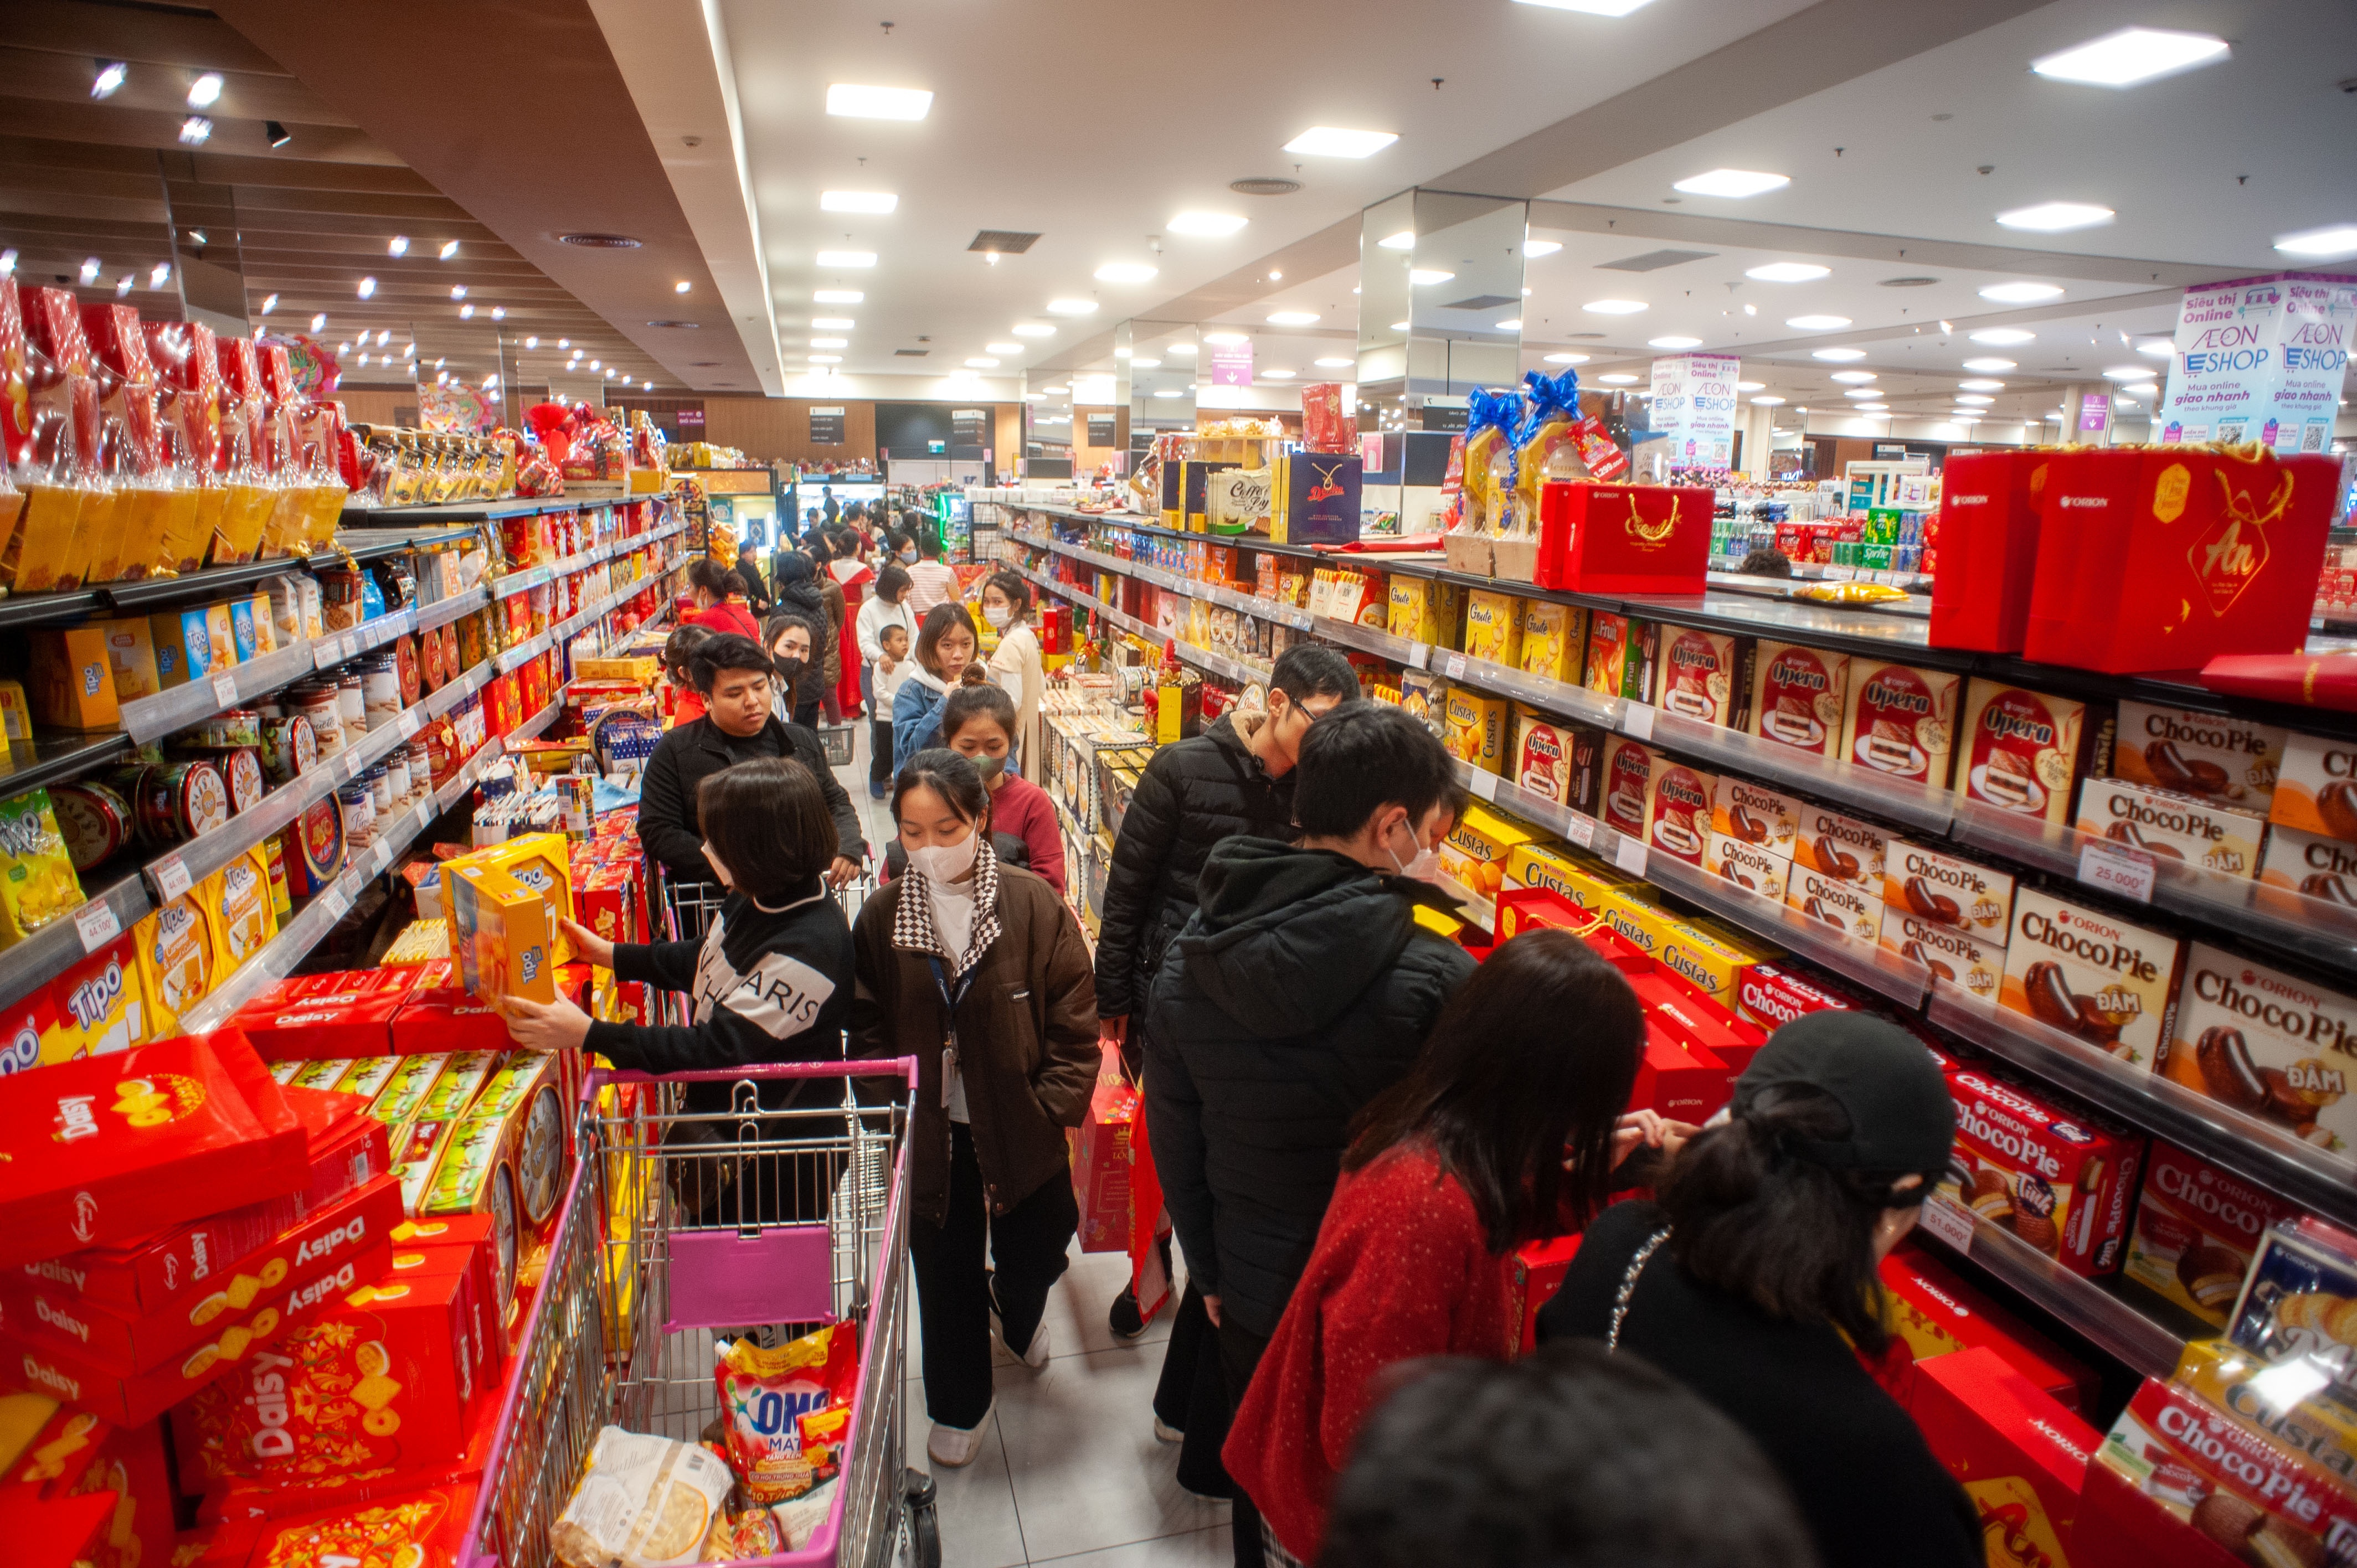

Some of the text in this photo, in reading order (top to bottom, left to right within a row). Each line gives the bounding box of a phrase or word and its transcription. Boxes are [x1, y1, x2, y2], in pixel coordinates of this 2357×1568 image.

[2186, 293, 2237, 310] Siêu thị
[2287, 301, 2325, 315] Online
[2289, 286, 2329, 300] Siêu thị
[2183, 311, 2233, 324] Online
[1708, 362, 1718, 370] thị
[2182, 348, 2269, 376] ESHOP
[2284, 348, 2348, 373] ESHOP
[2175, 391, 2250, 406] giao nhanh
[2188, 381, 2241, 392] Mua online
[2274, 392, 2332, 403] giao nhanh
[2286, 380, 2301, 389] Mua
[1654, 397, 1685, 411] ESHOP
[1692, 396, 1736, 411] ESHOP
[2200, 404, 2224, 413] khung
[1961, 496, 1988, 505] ORION
[2073, 497, 2108, 508] ORION
[1864, 547, 1889, 559] Sprite
[187, 630, 207, 649] Tipo
[236, 620, 252, 636] Tipo
[1670, 643, 1715, 670] Opéra
[85, 666, 100, 697] Tipo
[1772, 662, 1825, 691] Opéra
[1448, 698, 1477, 723] Custas
[1866, 680, 1930, 715] Opéra
[1483, 709, 1497, 759] Custas
[1984, 706, 2054, 745] Opéra
[1527, 734, 1559, 757] Opéra
[1617, 752, 1650, 778] Opéra
[1660, 777, 1703, 807] Opéra
[1731, 786, 1786, 817] ChocoPie
[2108, 793, 2225, 842] ChocoPie
[1815, 815, 1882, 852] ChocoPie
[1550, 865, 1567, 879] ORION
[1722, 840, 1773, 875] ChocoPie
[1937, 858, 1960, 869] ORION
[224, 864, 250, 890] Tipo
[1525, 862, 1585, 909] Custas
[1905, 853, 1987, 895] ChocoPie
[1805, 876, 1865, 915] ChocoPie
[157, 903, 187, 935] Tipo
[1605, 909, 1654, 949] Custas
[1625, 910, 1641, 922] ORION
[2068, 914, 2122, 941] ORION
[1687, 947, 1704, 961] ORION
[1902, 918, 1982, 963] ChocoPie
[2021, 910, 2158, 984] ChocoPie
[521, 950, 539, 985] Tipo
[1663, 944, 1717, 991] Custas
[69, 962, 122, 1033] Tipo
[295, 994, 357, 1007] Daisy
[740, 970, 819, 1022] ARIS
[1743, 983, 1804, 1029] Choco
[1773, 990, 1804, 1009] ORION
[2258, 974, 2322, 1007] ORION
[275, 1010, 339, 1025] Daisy
[452, 1005, 497, 1015] Dais
[2194, 967, 2357, 1061] ChocoPie
[2157, 1002, 2175, 1060] ChocoPie
[1955, 1073, 2051, 1125] ChocoPie
[52, 1095, 99, 1142] Daisy
[1988, 1107, 2032, 1138] ORION
[2108, 1157, 2136, 1235] ChocoPie
[2155, 1163, 2261, 1237] Choco
[2216, 1178, 2273, 1215] ORION
[192, 1232, 208, 1281] Daisy
[295, 1215, 366, 1267] Daisy
[2285, 1251, 2318, 1273] ORION
[287, 1262, 357, 1316] Daisy
[1915, 1276, 1956, 1309] ORION
[34, 1295, 90, 1343] Daisy
[472, 1302, 484, 1368] Daisy
[23, 1353, 80, 1401] Daisy
[459, 1335, 472, 1402] Daisy
[245, 1351, 294, 1459] Daisy
[2032, 1419, 2089, 1463] ORION
[2225, 1384, 2357, 1475] Custa
[2225, 1426, 2283, 1471] ORION
[2157, 1405, 2323, 1524] ChocoPie
[752, 1490, 765, 1502] 10
